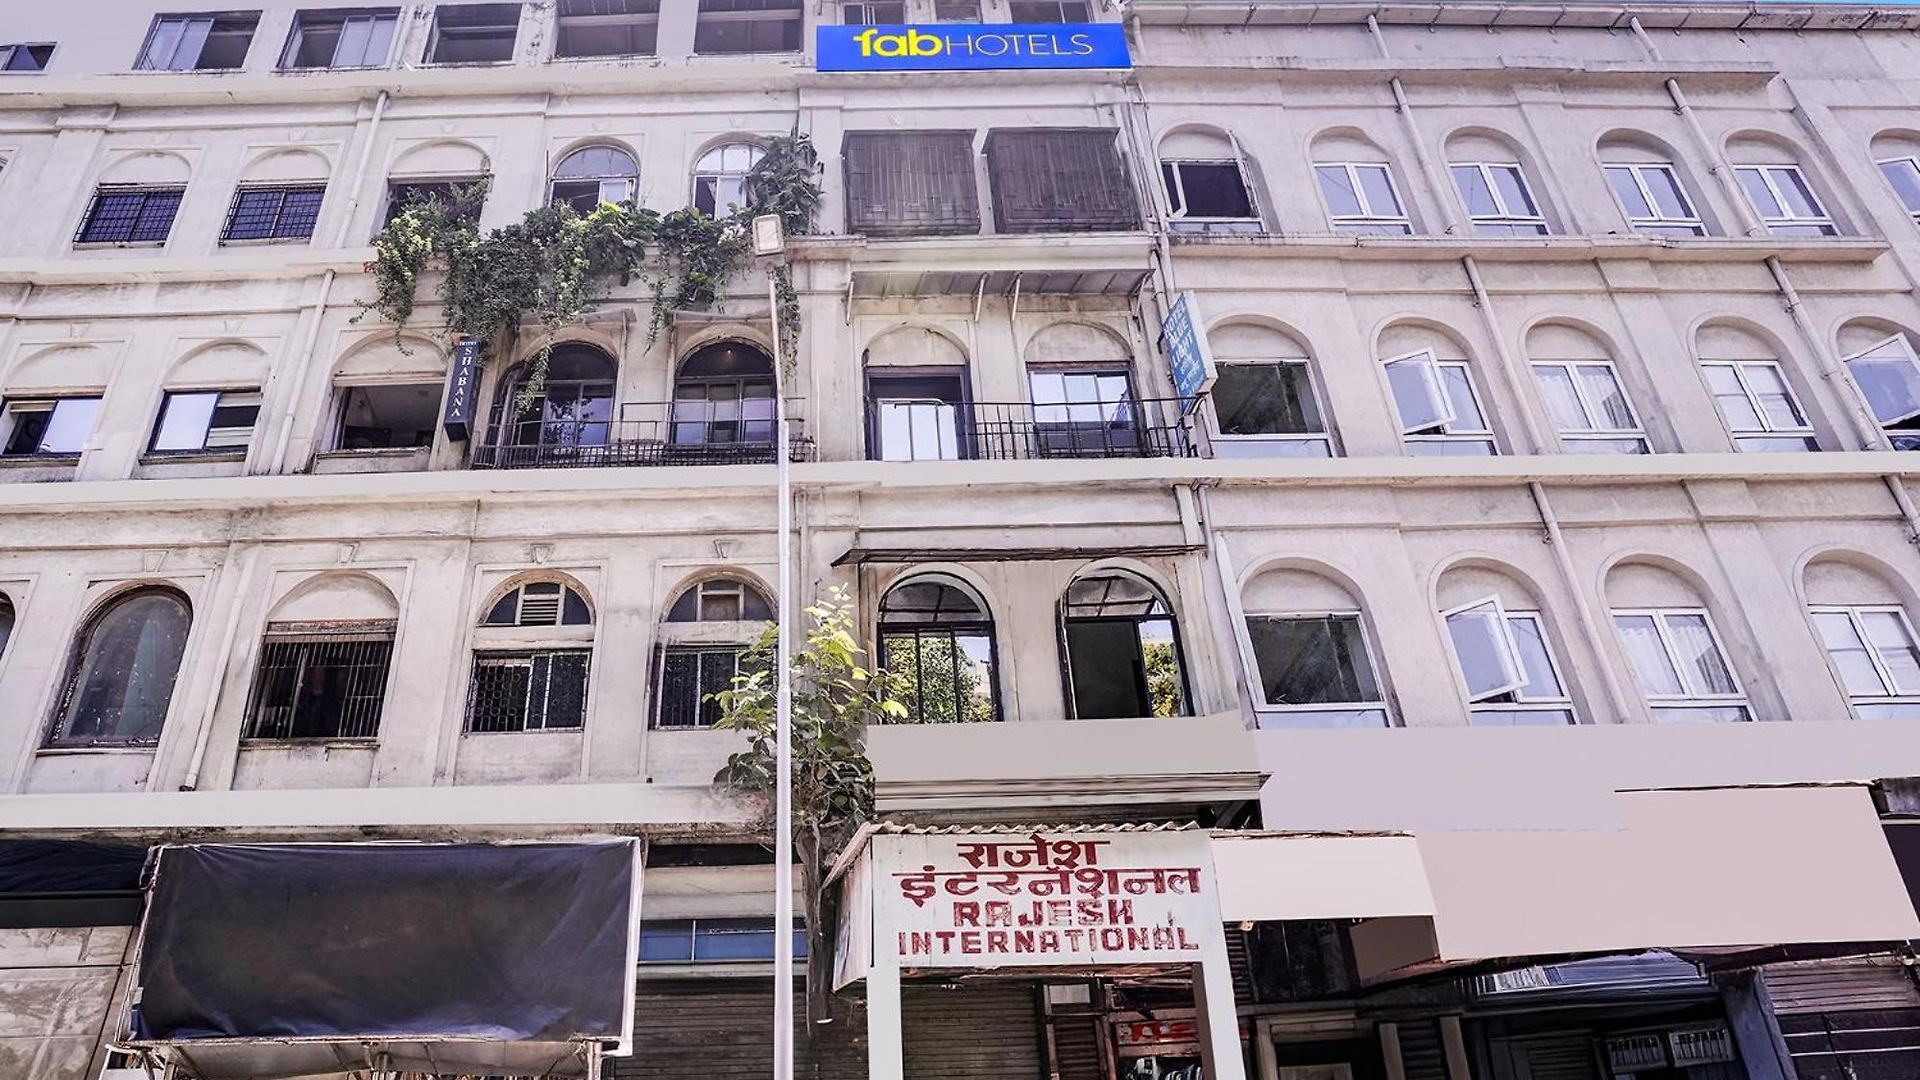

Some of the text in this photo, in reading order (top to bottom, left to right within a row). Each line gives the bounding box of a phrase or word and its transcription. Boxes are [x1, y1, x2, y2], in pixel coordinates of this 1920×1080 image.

[853, 28, 1093, 57] fabHOTELS
[451, 347, 473, 417] SHABANA
[956, 833, 1111, 870] राजेश
[953, 898, 1135, 928] RAJESH
[898, 926, 1199, 956] INTERNATIONAL
